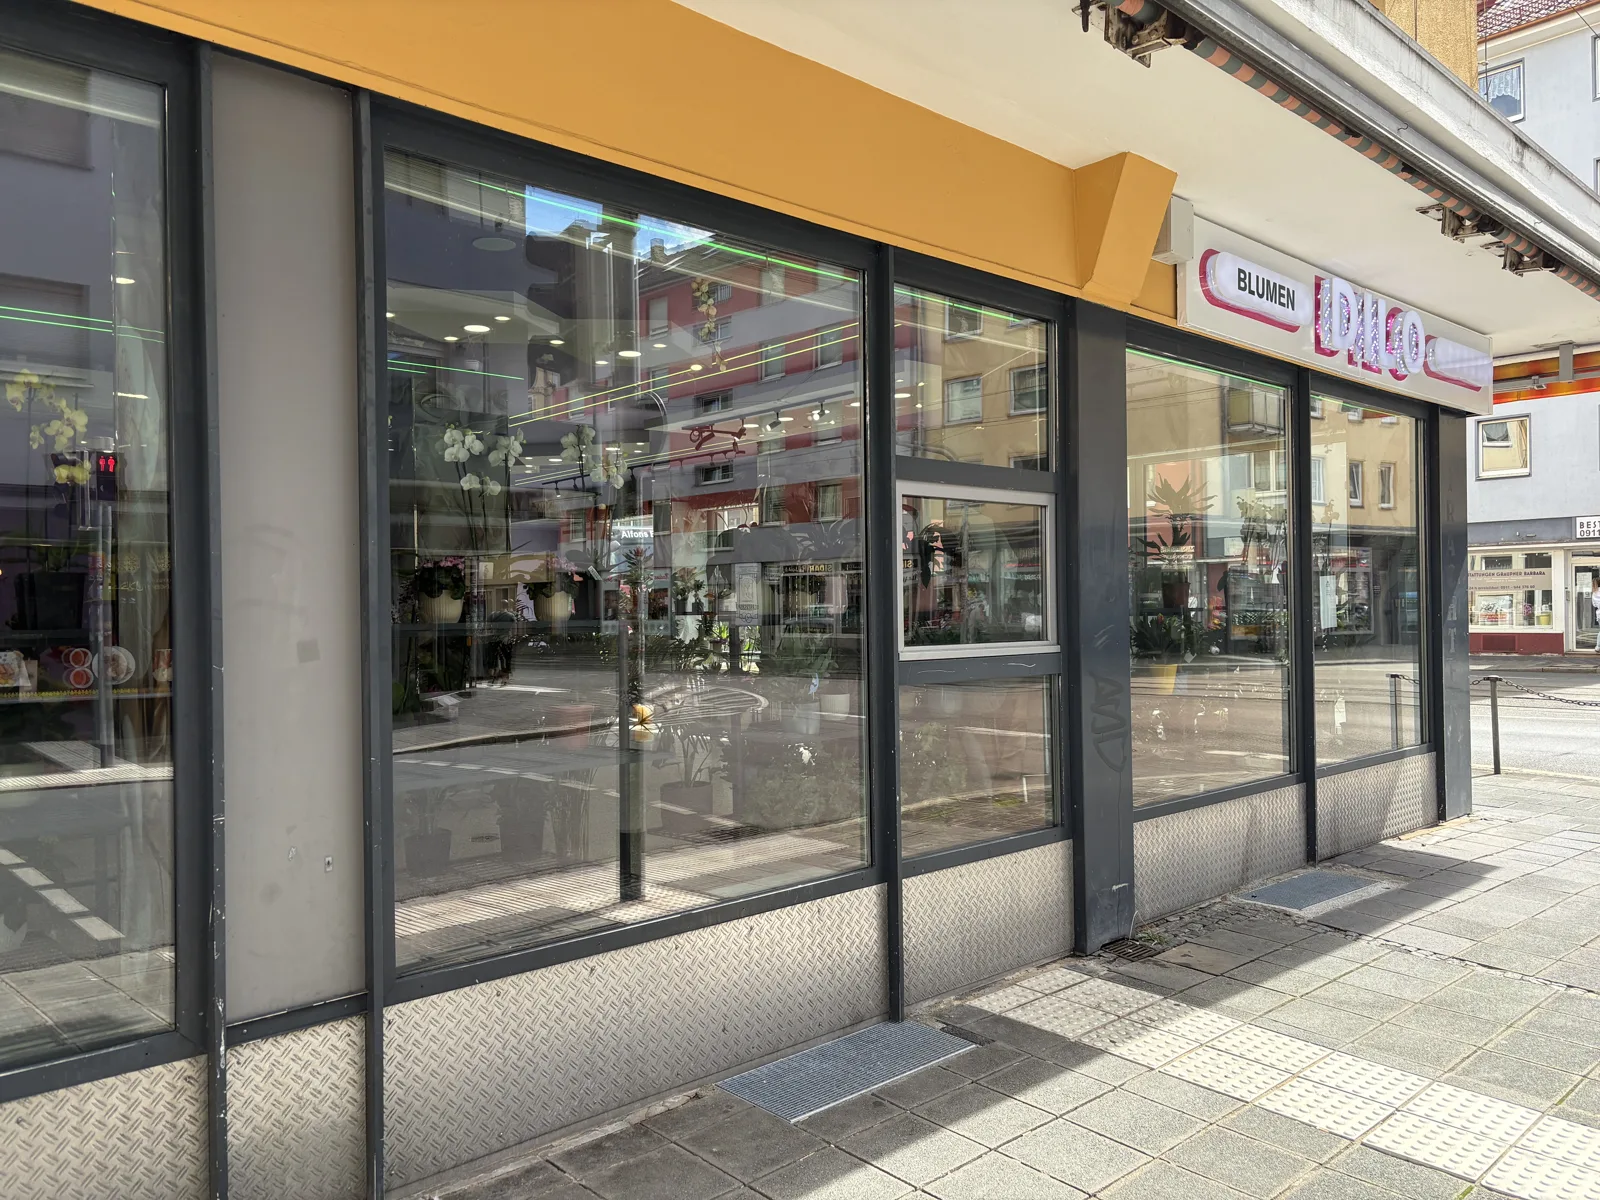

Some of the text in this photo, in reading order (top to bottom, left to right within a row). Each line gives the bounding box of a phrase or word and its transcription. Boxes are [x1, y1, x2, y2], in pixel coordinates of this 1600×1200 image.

[1237, 267, 1295, 311] BLUMEN
[1321, 277, 1425, 374] DILO
[621, 530, 649, 538] Alfons
